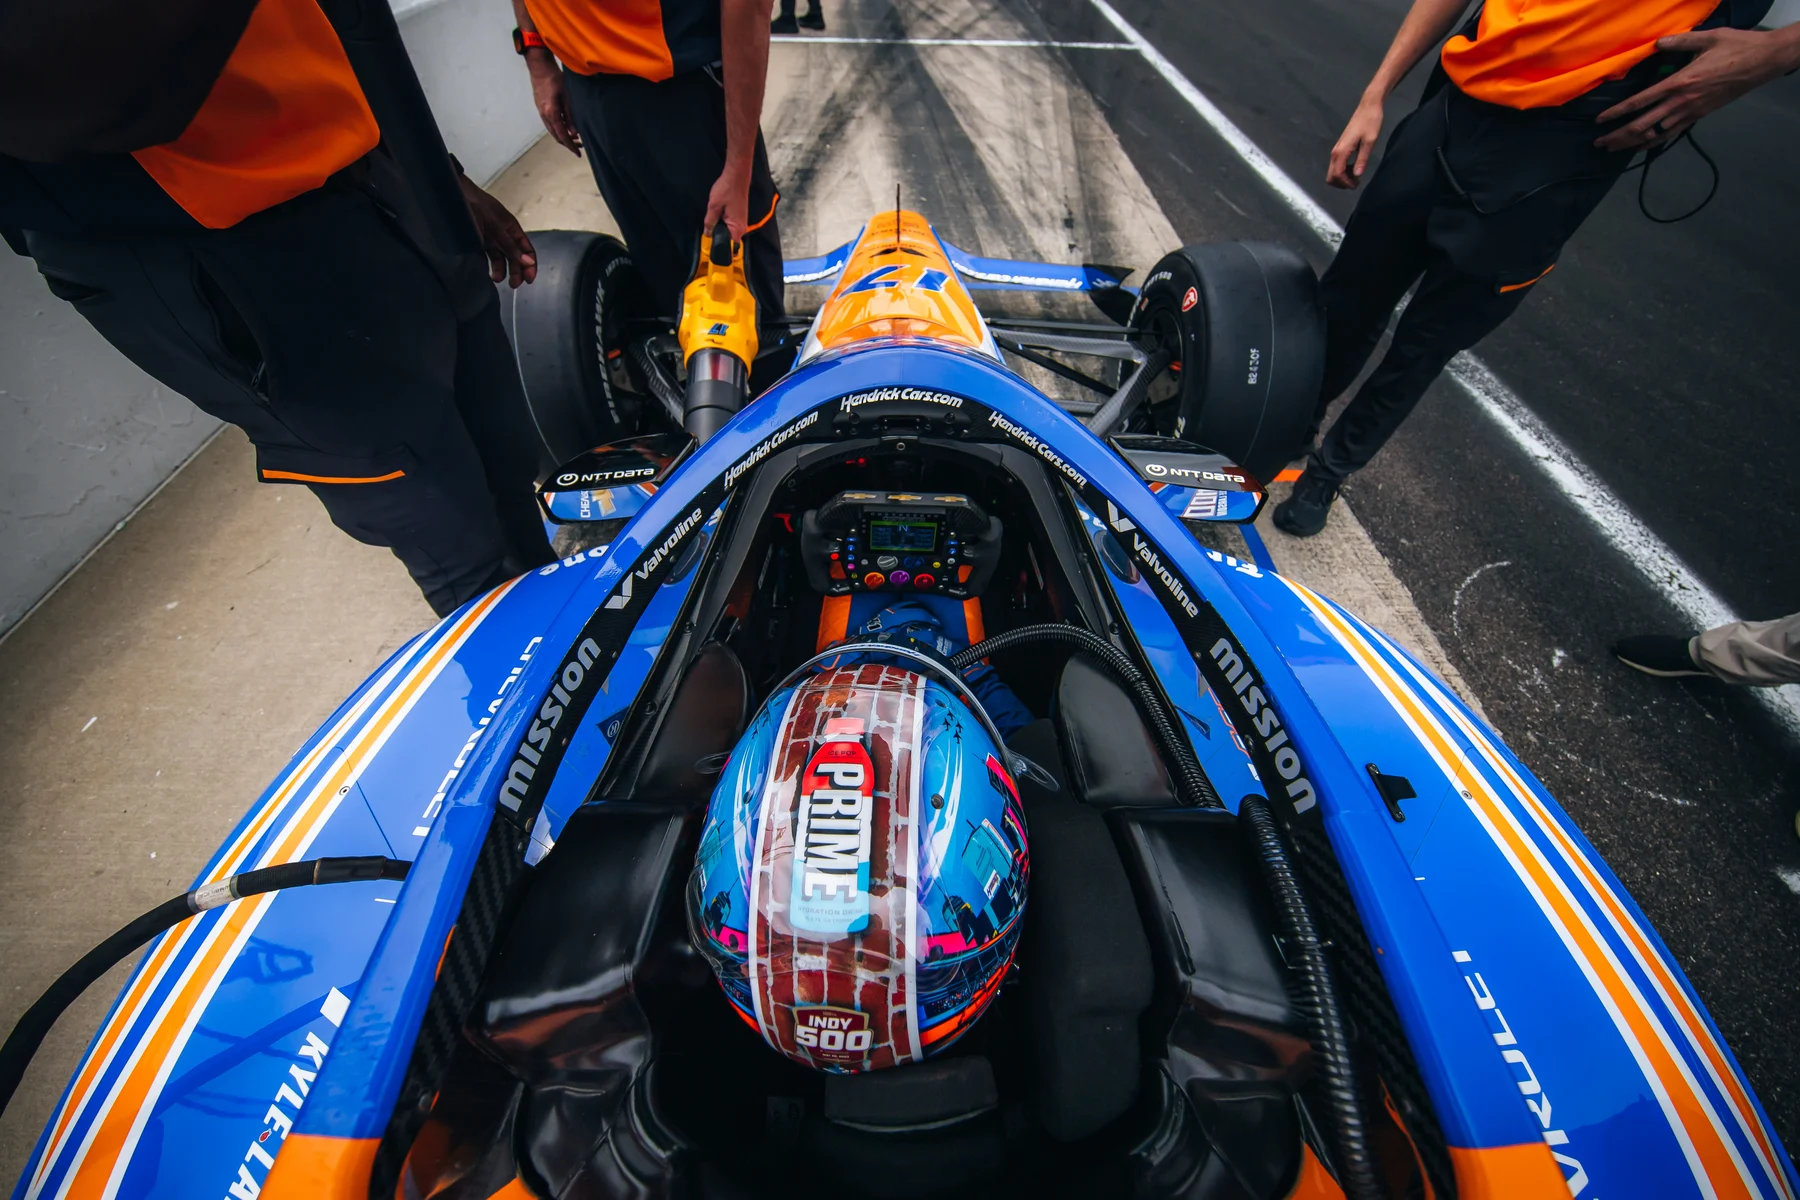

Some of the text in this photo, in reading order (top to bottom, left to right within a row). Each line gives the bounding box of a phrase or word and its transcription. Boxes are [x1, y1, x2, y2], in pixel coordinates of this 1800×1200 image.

[581, 471, 612, 482] NTT
[1170, 468, 1200, 478] NTT
[636, 507, 702, 580] Valvoline
[1134, 533, 1199, 618] Valvoline
[804, 763, 865, 903] PRIME
[795, 1025, 872, 1051] 500
[808, 1014, 852, 1031] INDY
[223, 1031, 330, 1200] KYLE LA
